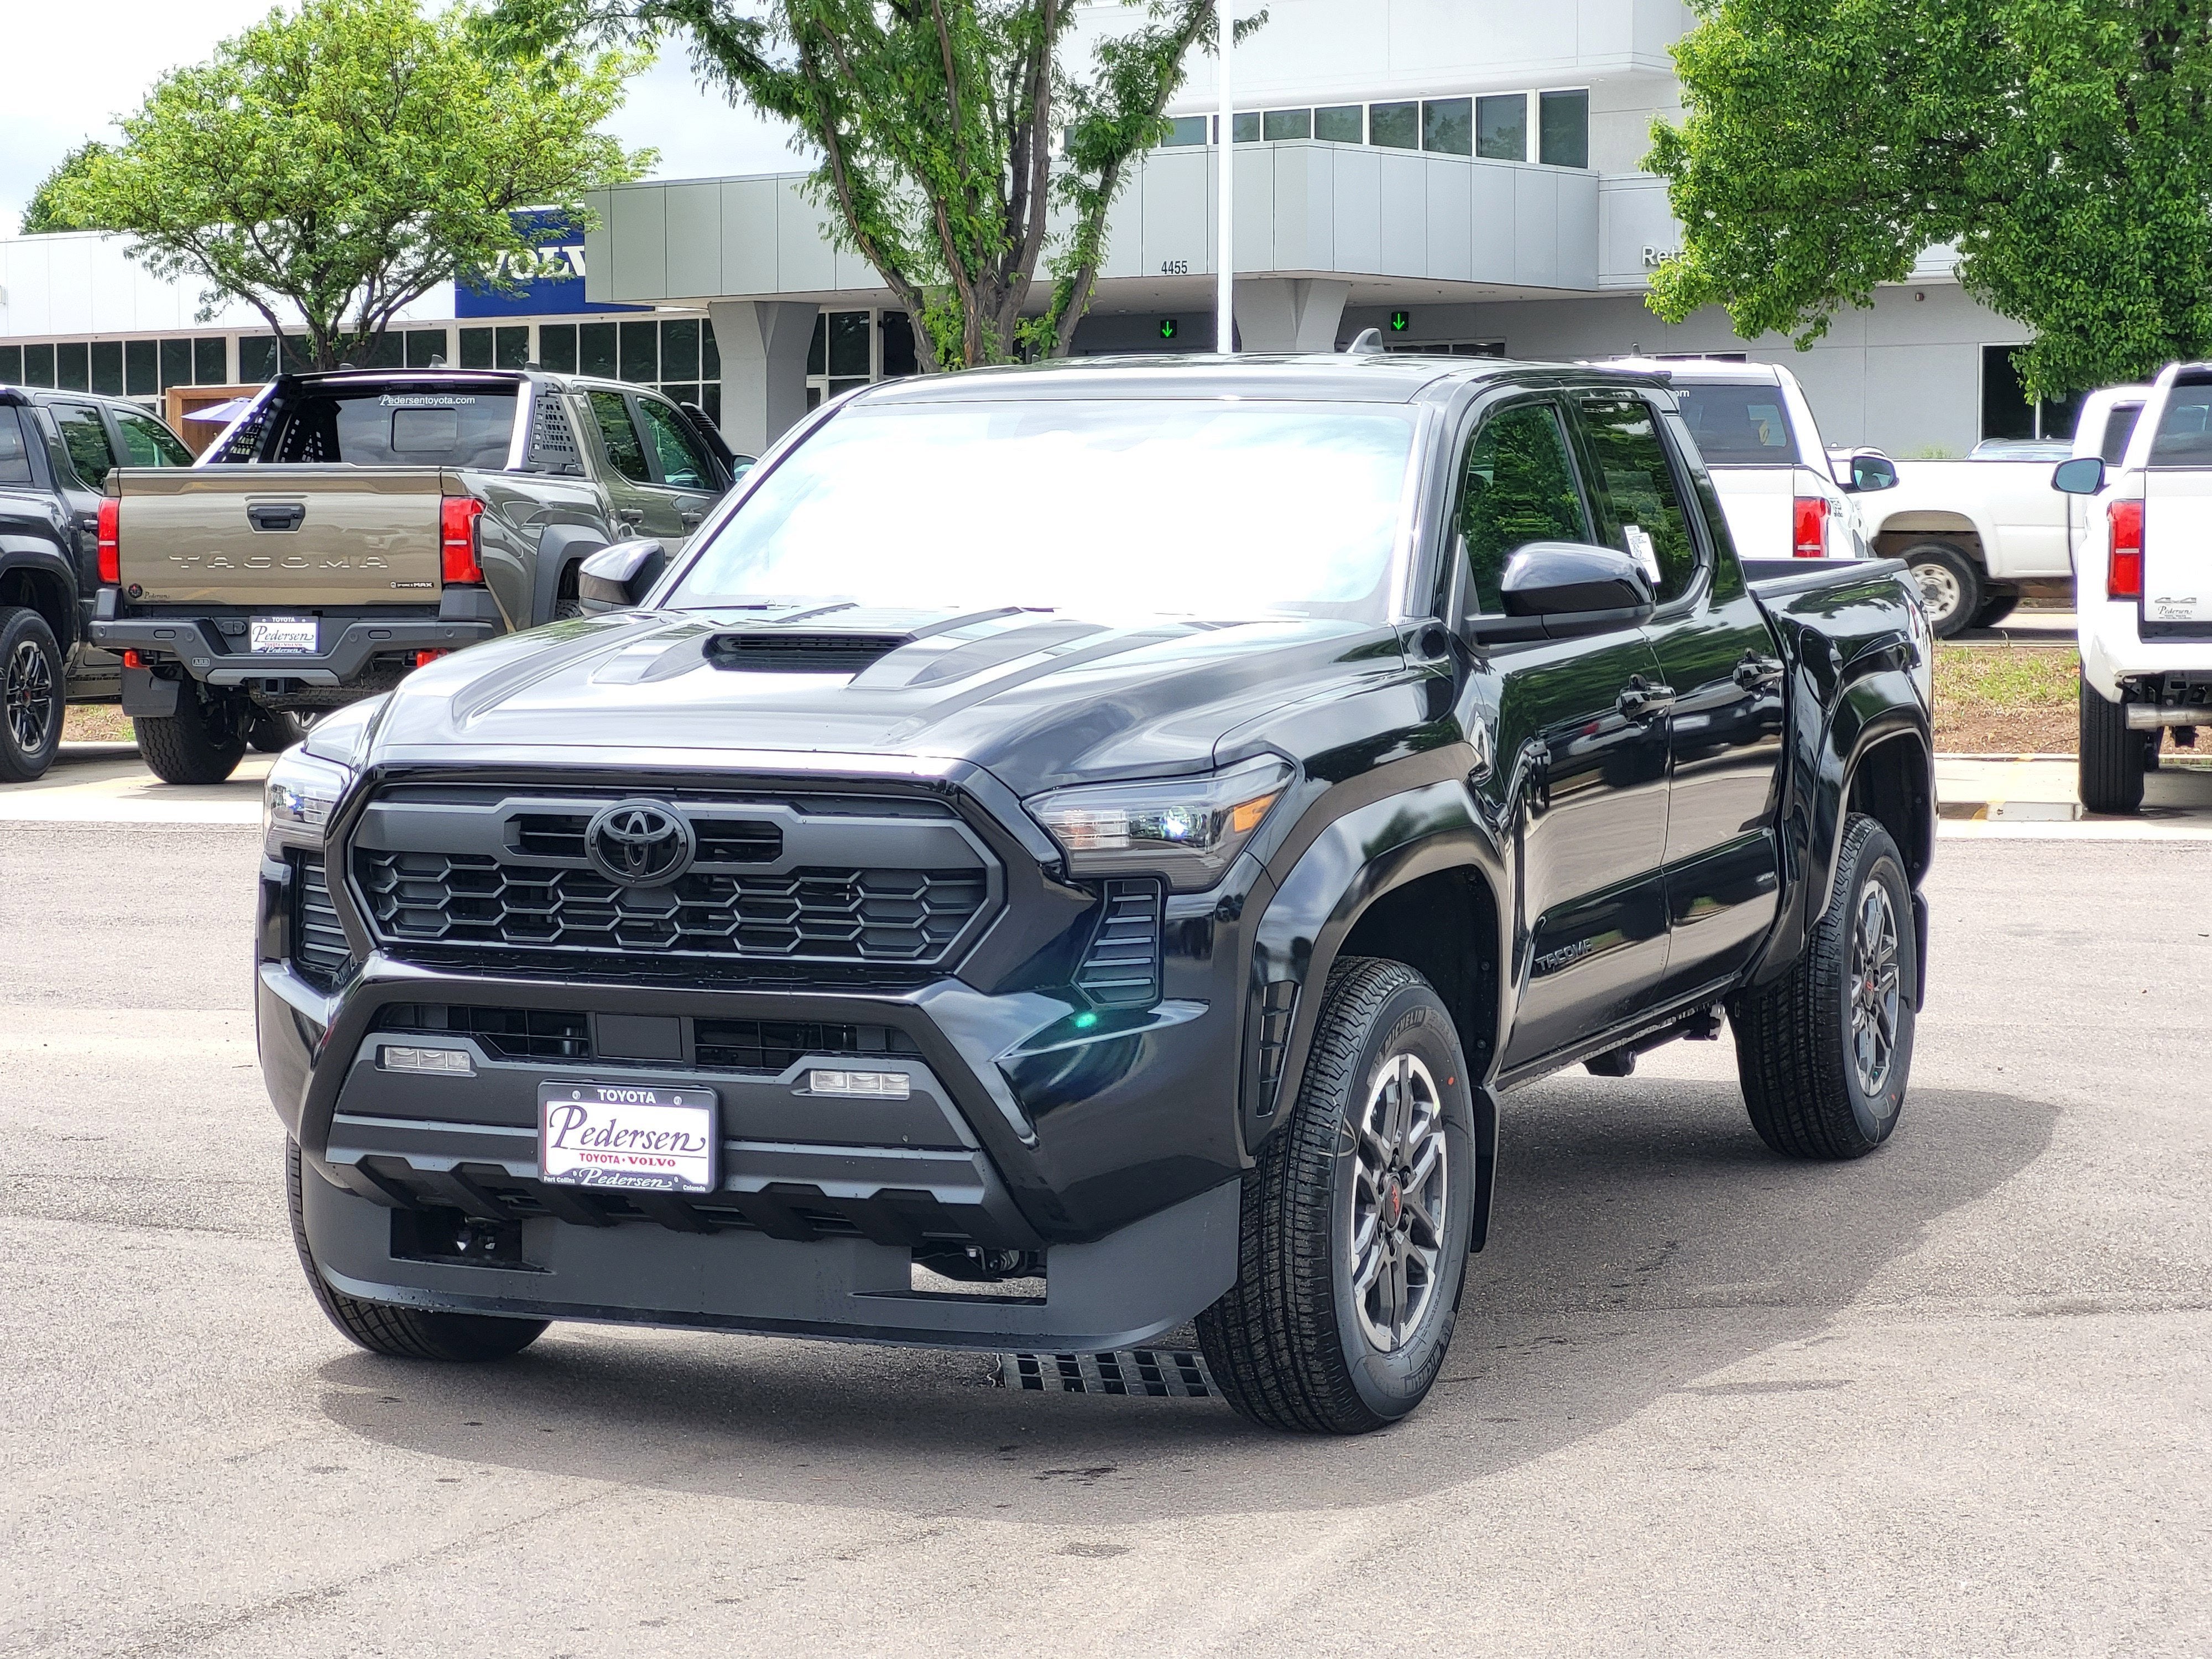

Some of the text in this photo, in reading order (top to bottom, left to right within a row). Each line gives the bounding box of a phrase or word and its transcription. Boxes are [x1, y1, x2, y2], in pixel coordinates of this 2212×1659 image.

[1161, 260, 1187, 274] 4455
[378, 394, 476, 406] Pedersentoyota.com
[168, 555, 388, 569] TACOMA
[252, 625, 314, 642] Pedersen
[1384, 1010, 1425, 1055] MICHELIN
[597, 1088, 656, 1104] TOYOTA
[549, 1105, 706, 1152] Pedersen
[579, 1152, 676, 1167] TOYOTA VOLVO
[578, 1167, 672, 1188] Pedersen
[683, 1184, 706, 1192] Colorado
